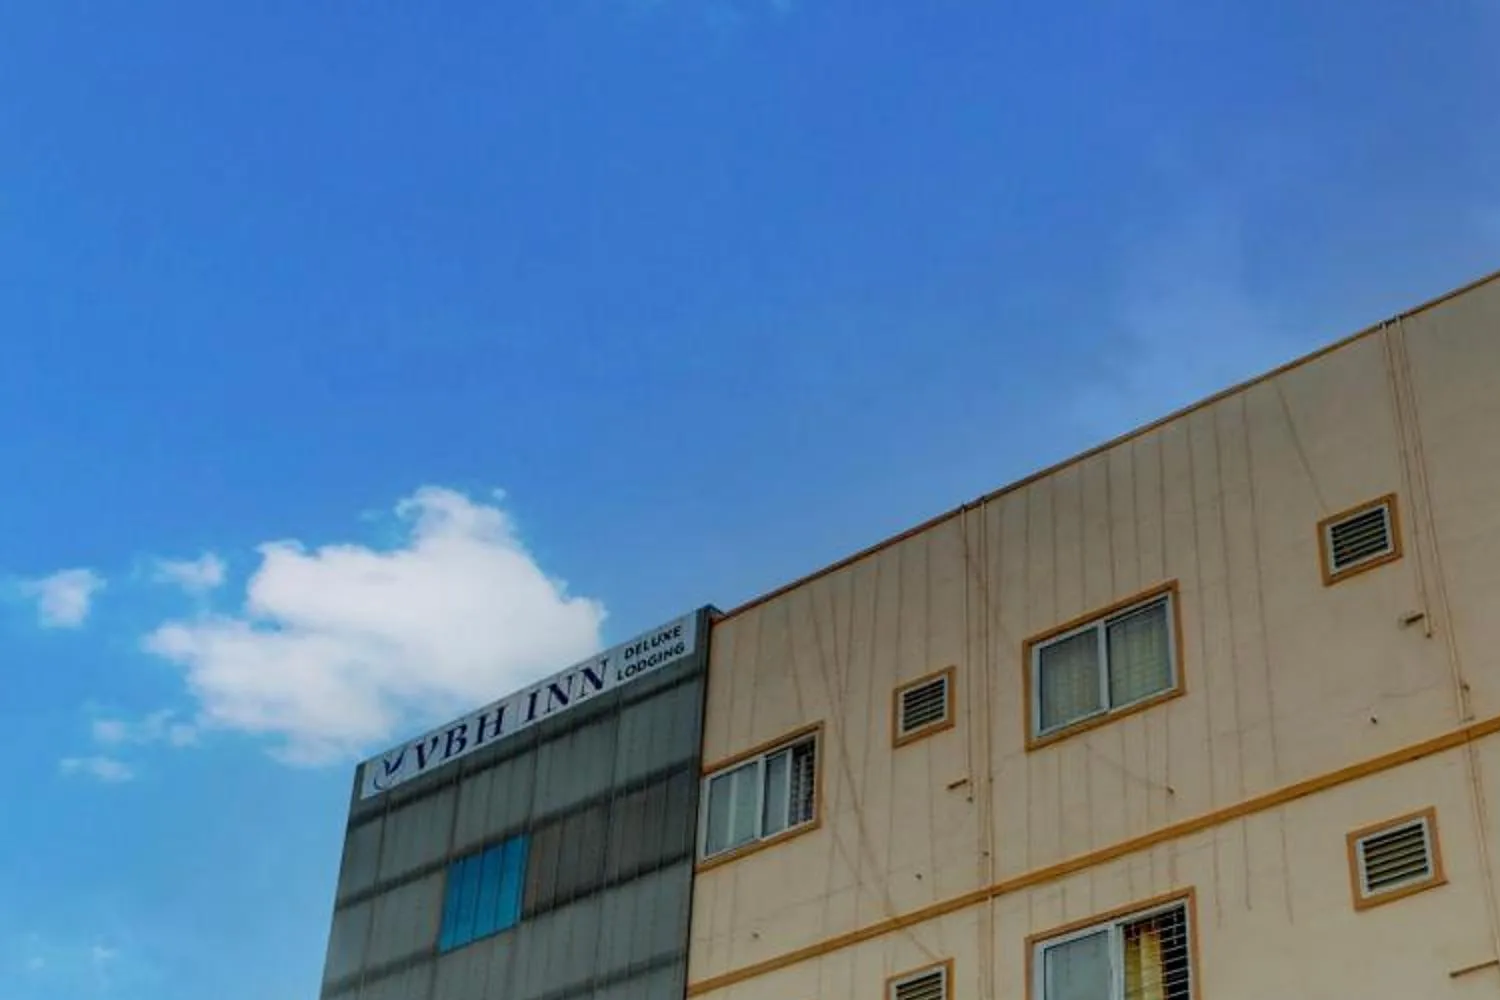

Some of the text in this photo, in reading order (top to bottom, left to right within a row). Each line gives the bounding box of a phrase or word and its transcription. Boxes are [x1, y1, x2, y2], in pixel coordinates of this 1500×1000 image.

[617, 642, 685, 681] LODGING
[623, 625, 682, 660] DELUXE
[414, 659, 611, 770] VBH INN
